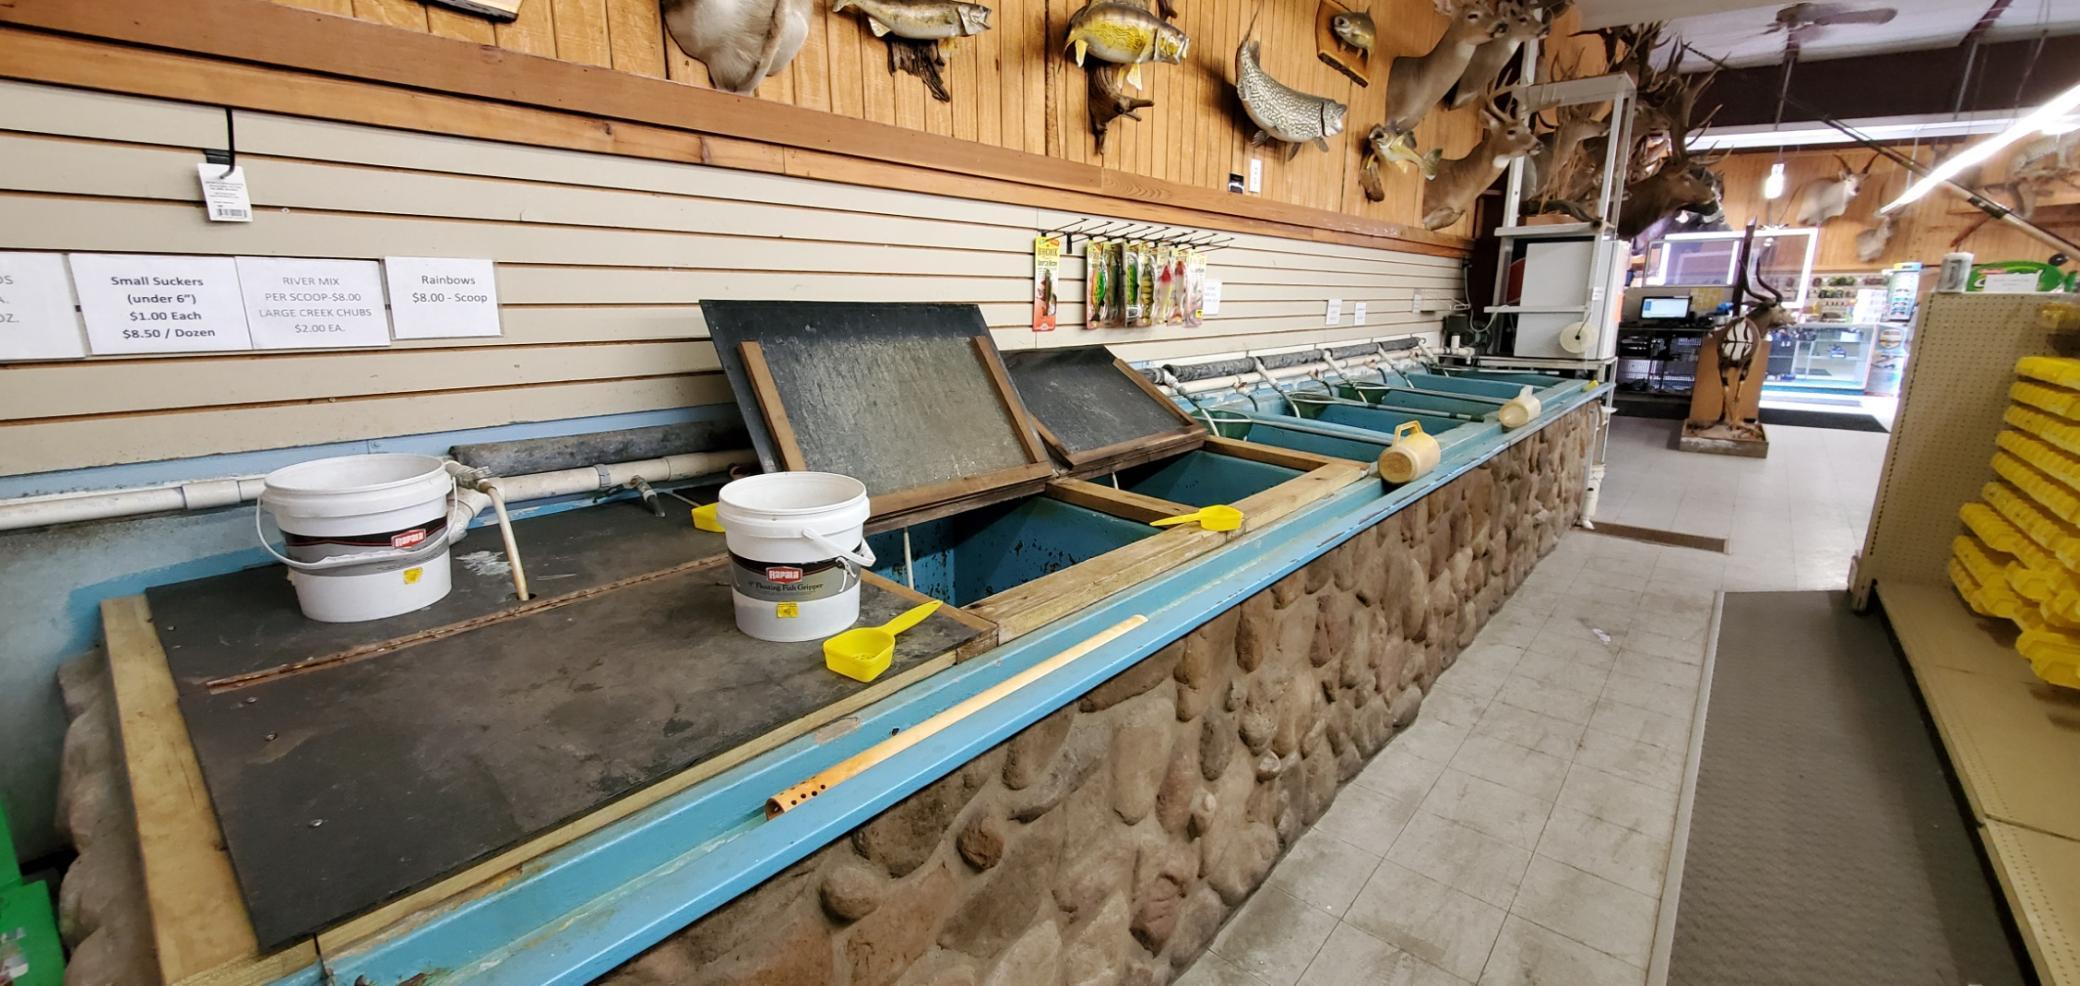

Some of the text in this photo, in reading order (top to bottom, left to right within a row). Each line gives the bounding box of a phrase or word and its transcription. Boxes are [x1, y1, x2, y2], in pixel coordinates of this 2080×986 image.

[110, 276, 204, 286] Small Suckers
[282, 277, 340, 286] RIVER MIX
[421, 275, 476, 285] Rainbows
[127, 294, 173, 305] (under
[265, 293, 361, 302] PER SCOOP-$8.00
[412, 292, 445, 303] $8.00
[454, 293, 488, 303] Scoop
[129, 311, 202, 321] $1.00 Each
[259, 309, 372, 318] LARGE CREEK CHUBS
[294, 324, 346, 333] $2.00 EA.
[122, 329, 216, 339] $8.50 / Dozen
[797, 583, 824, 592] Gripper
